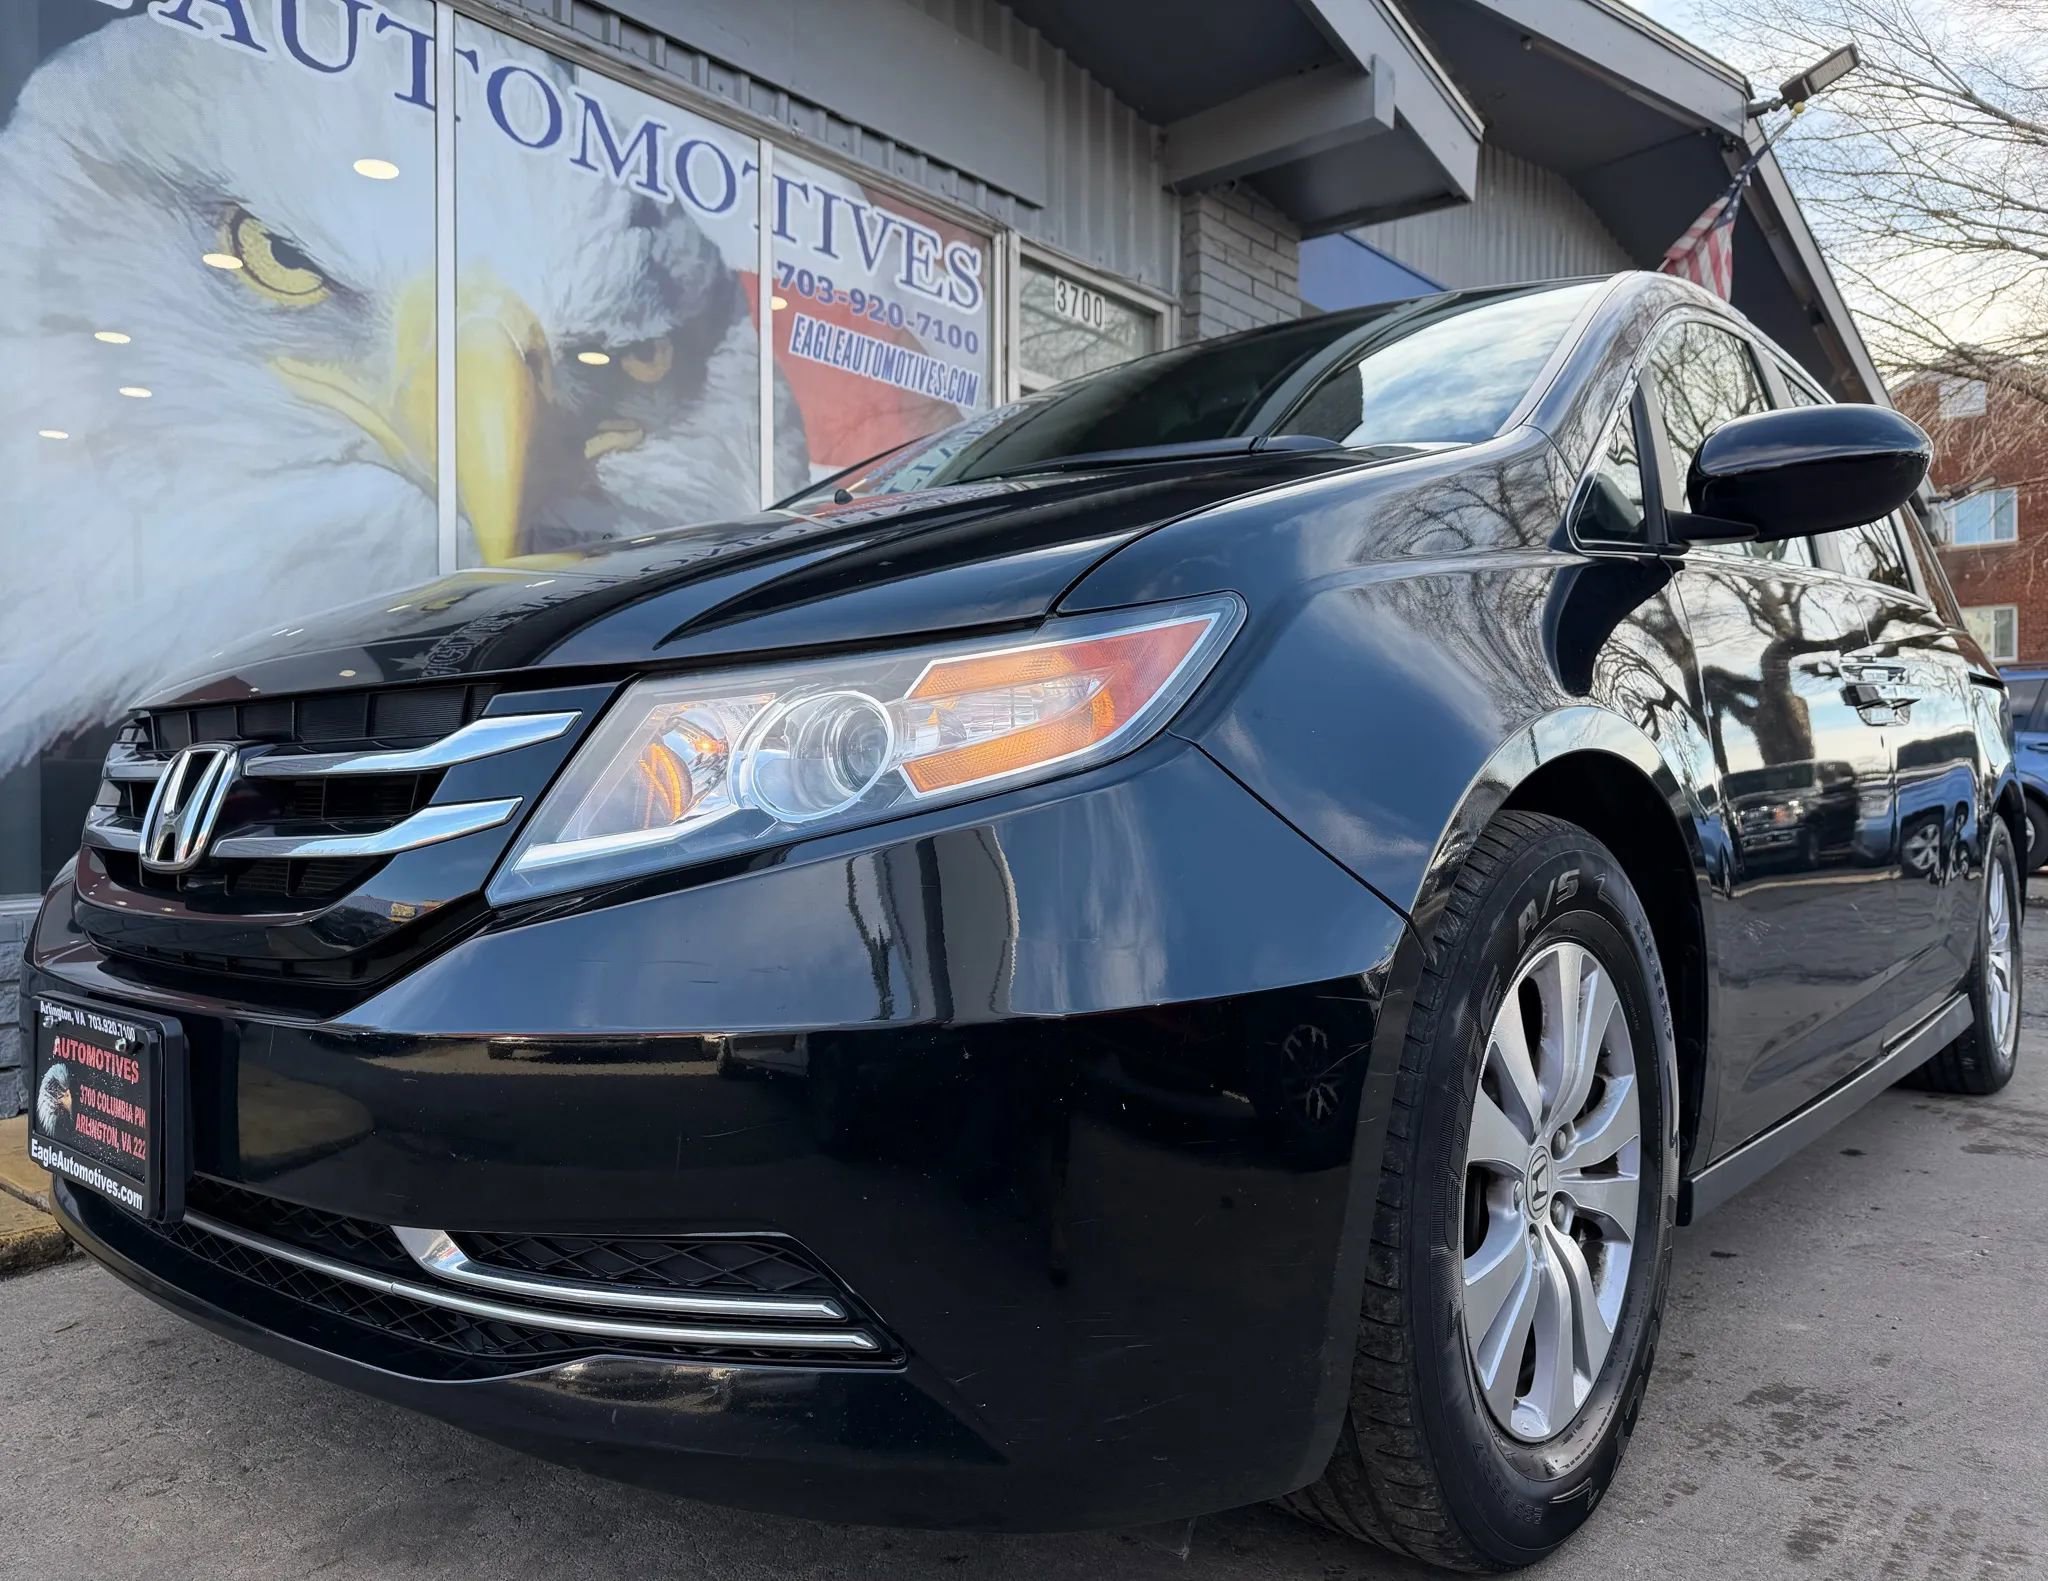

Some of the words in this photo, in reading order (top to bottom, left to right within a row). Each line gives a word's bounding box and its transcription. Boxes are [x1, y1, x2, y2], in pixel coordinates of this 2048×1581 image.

[777, 260, 979, 355] 703-920-7100
[1057, 280, 1103, 328] 3700
[791, 314, 979, 407] EAGLEAUTOMOTIVES.COM
[1516, 868, 1582, 954] A/S
[40, 1000, 75, 1025] Arlington,
[74, 1010, 86, 1026] VA
[88, 1014, 136, 1042] 703.920.7100
[53, 1035, 139, 1083] AUTOMOTIVES
[80, 1085, 96, 1108] 3700
[97, 1092, 134, 1124] COLUMBIA
[75, 1112, 119, 1151] ARLINGTON,
[121, 1131, 132, 1153] VA
[31, 1138, 143, 1211] EagleAutomotives.com
